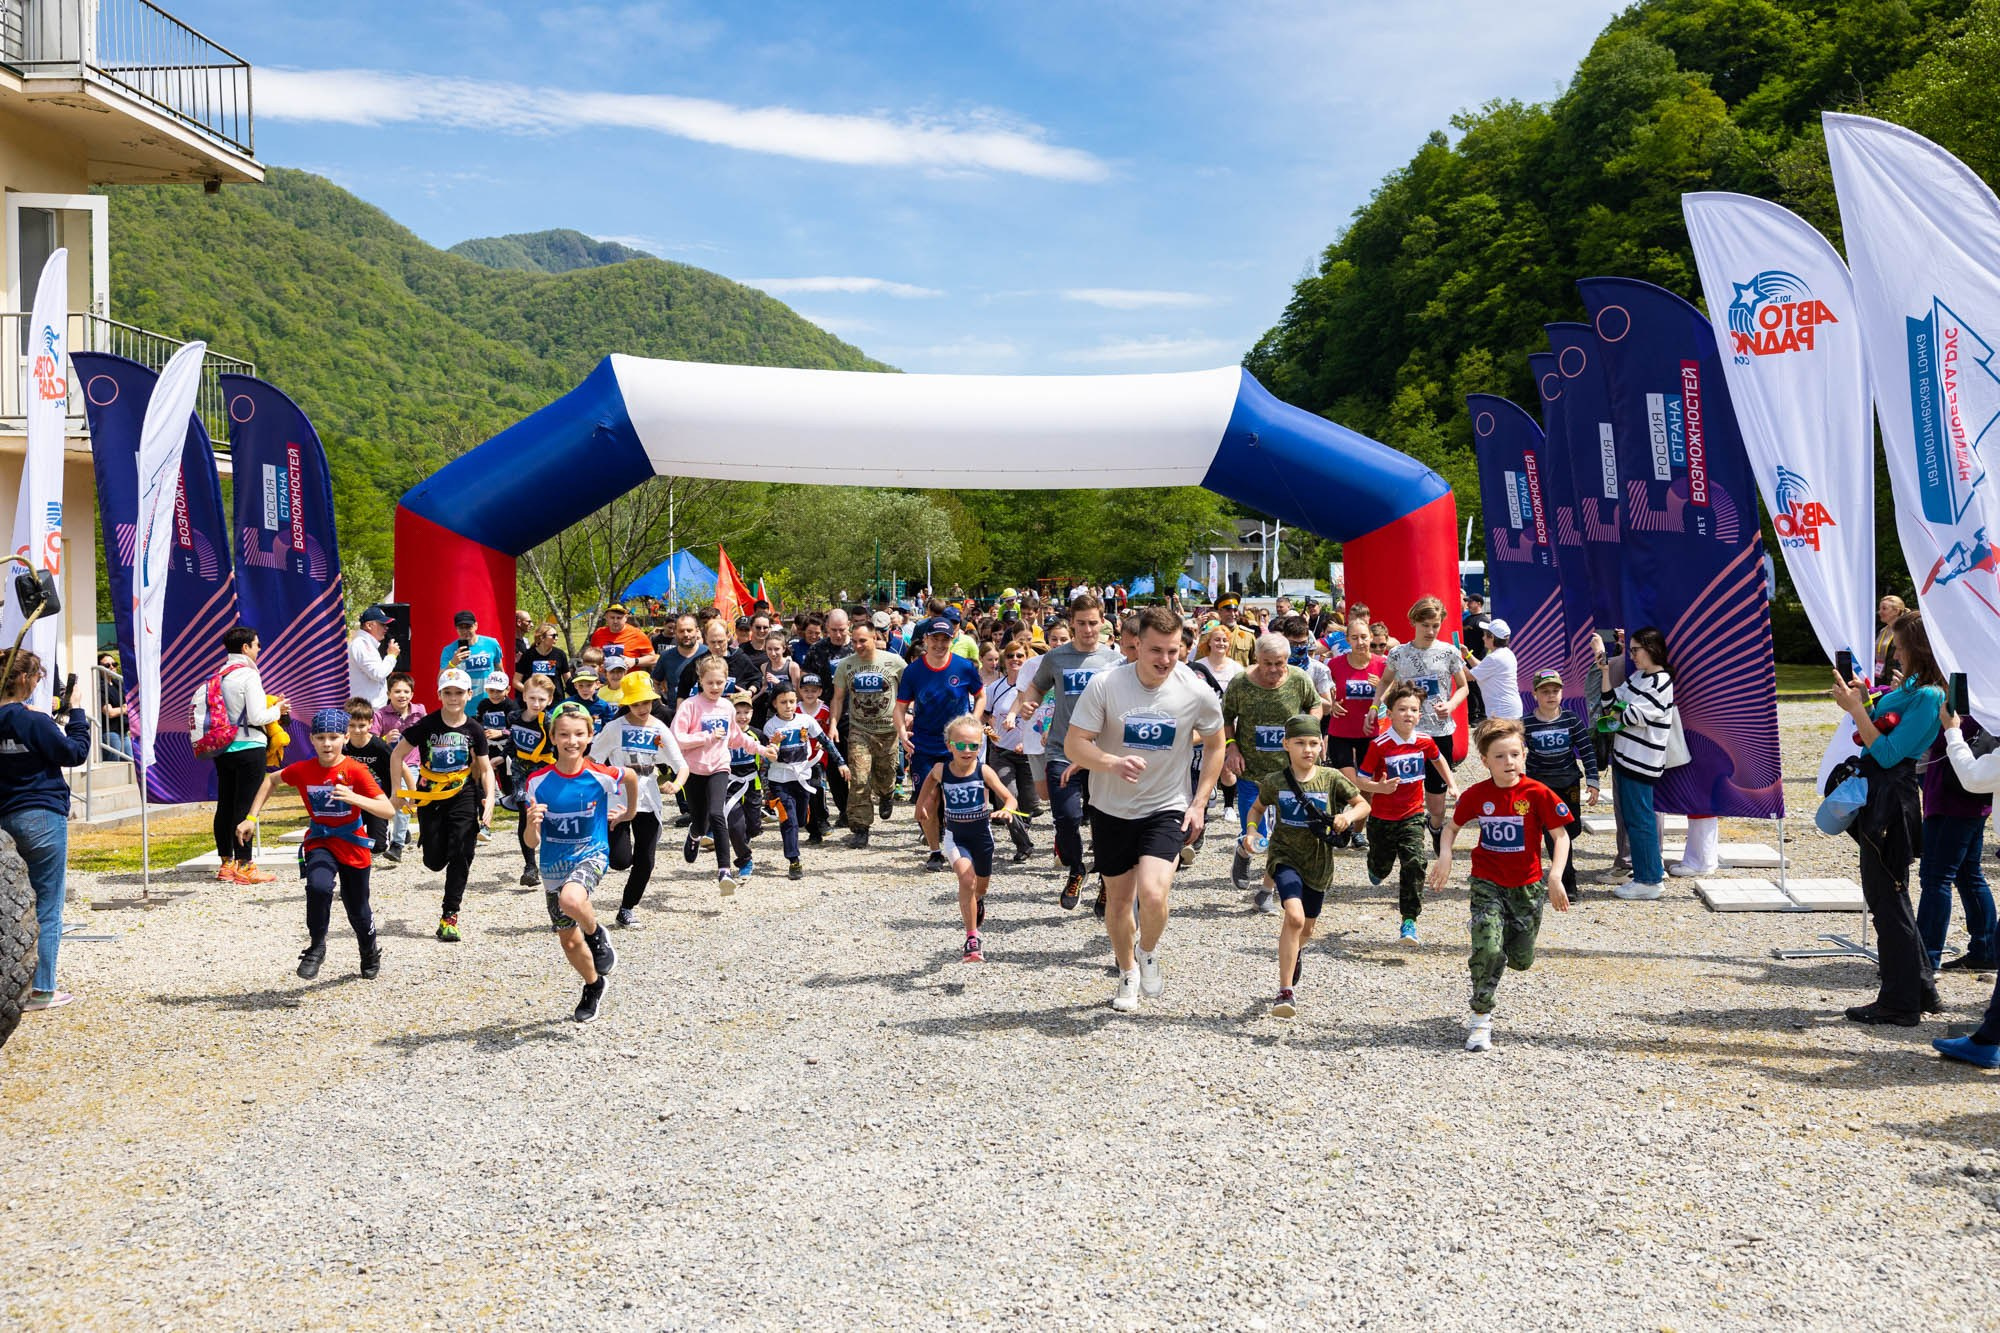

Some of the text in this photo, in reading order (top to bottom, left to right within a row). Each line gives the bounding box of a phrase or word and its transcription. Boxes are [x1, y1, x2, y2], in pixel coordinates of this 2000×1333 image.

[1669, 400, 1684, 463] СТРАНА
[1681, 367, 1706, 503] ВОЗМОЖНОСТЕЙ
[1652, 412, 1668, 476] РОССИЯ
[1603, 439, 1616, 494] РОССИЯ
[266, 478, 277, 528] РОССИЯ
[279, 471, 289, 519] СТРАНА
[287, 448, 304, 550] ВОЗМОЖНОСТЕЙ
[1519, 475, 1532, 518] СТРАНА
[1524, 455, 1547, 544] ВОЗМОЖНОСТЕЙ
[1507, 483, 1520, 526] РОССИЯ
[1698, 515, 1706, 536] ЛЕТ
[186, 556, 194, 573] ЛЕТ
[469, 657, 488, 667] 149
[858, 676, 879, 687] 168
[1068, 672, 1093, 687] 14
[1350, 684, 1372, 694] 219
[514, 731, 535, 745] 118
[627, 731, 654, 745] 237
[1138, 725, 1162, 740] 69
[1539, 734, 1565, 748] 136
[446, 752, 456, 764] 8
[1392, 760, 1419, 776] 161
[948, 788, 979, 804] 337
[557, 818, 580, 835] 41
[1482, 824, 1517, 842] 160
